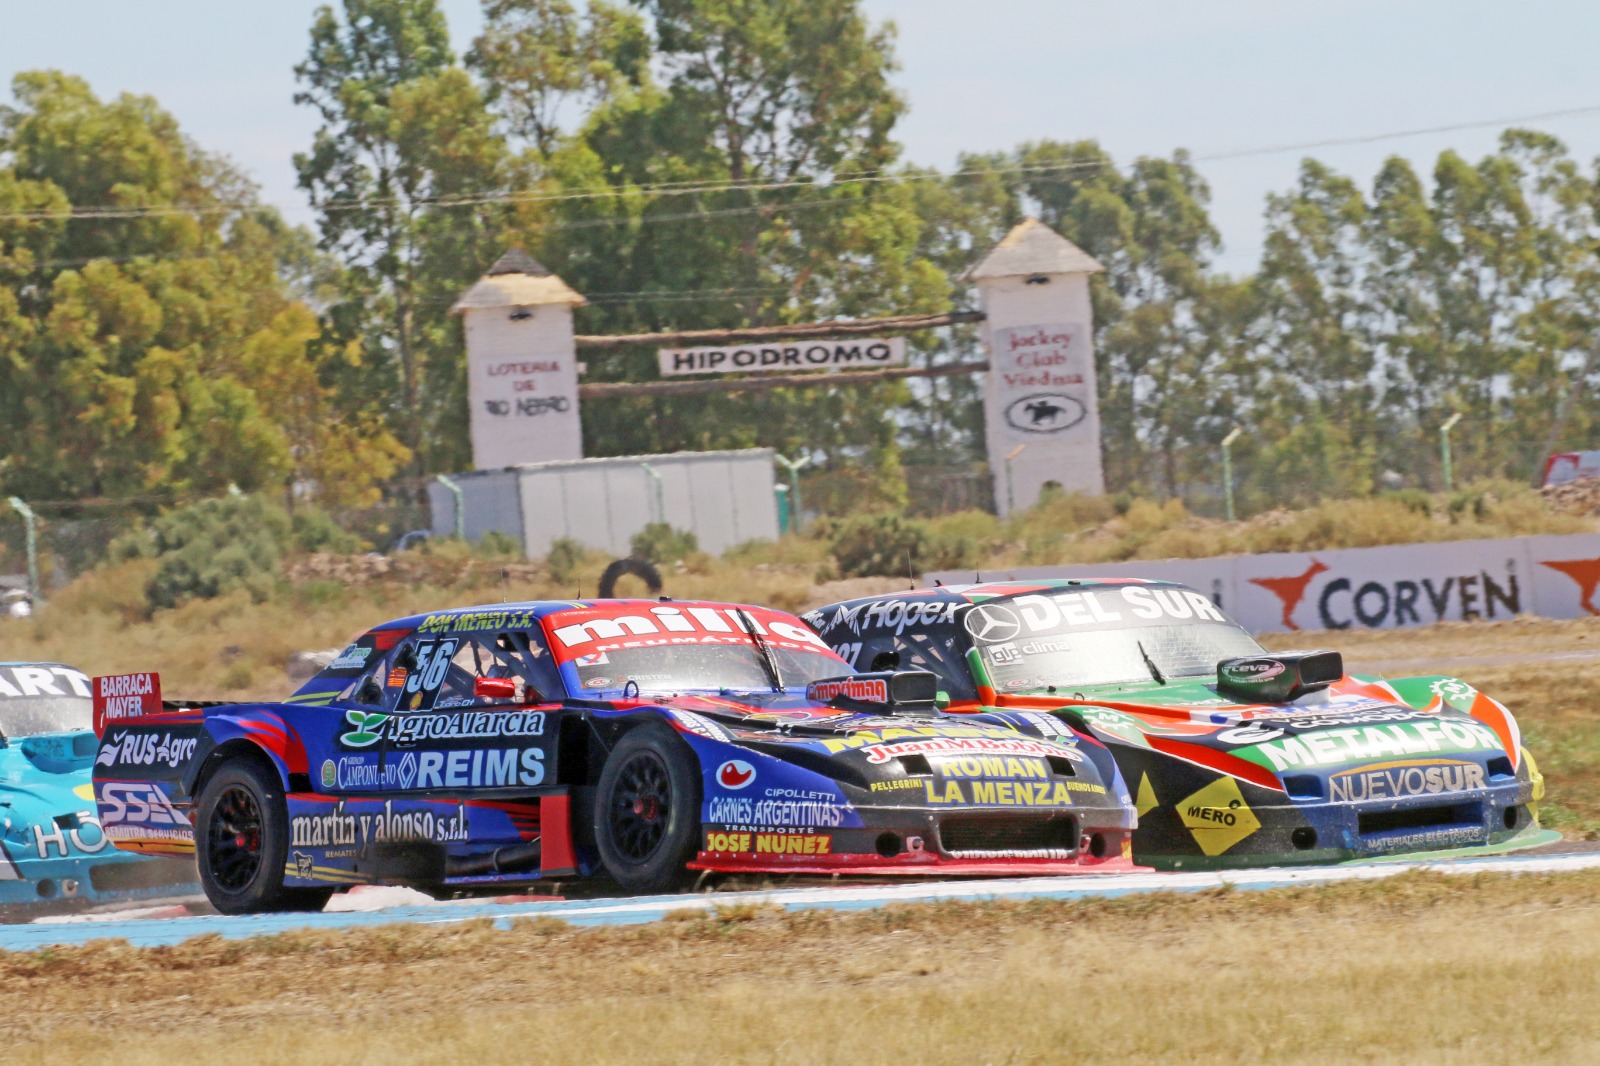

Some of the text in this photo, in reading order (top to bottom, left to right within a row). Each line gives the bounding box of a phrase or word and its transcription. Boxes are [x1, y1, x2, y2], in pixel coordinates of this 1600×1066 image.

[673, 343, 890, 370] HIPODROMO
[513, 380, 537, 392] DE
[1011, 593, 1122, 632] DEL
[1119, 585, 1226, 622] SUR
[1317, 569, 1520, 629] CORVEN
[407, 641, 454, 693] 56
[101, 674, 153, 698] BARRACA
[105, 697, 143, 719] MAYER
[1256, 719, 1505, 771] METALFOR
[416, 748, 545, 788] REIMS
[941, 757, 1047, 779] ROMAN
[765, 788, 836, 801] CIPOLLETTI
[870, 779, 923, 792] PELLEGRINI
[927, 781, 965, 804] LA
[973, 781, 1072, 805] MENZA
[709, 796, 840, 827] CARNES ARGENTINAS
[1187, 806, 1236, 826] MERO
[725, 824, 814, 834] TRANSPORTE
[325, 850, 357, 859] REMATES
[707, 833, 750, 852] JOSE
